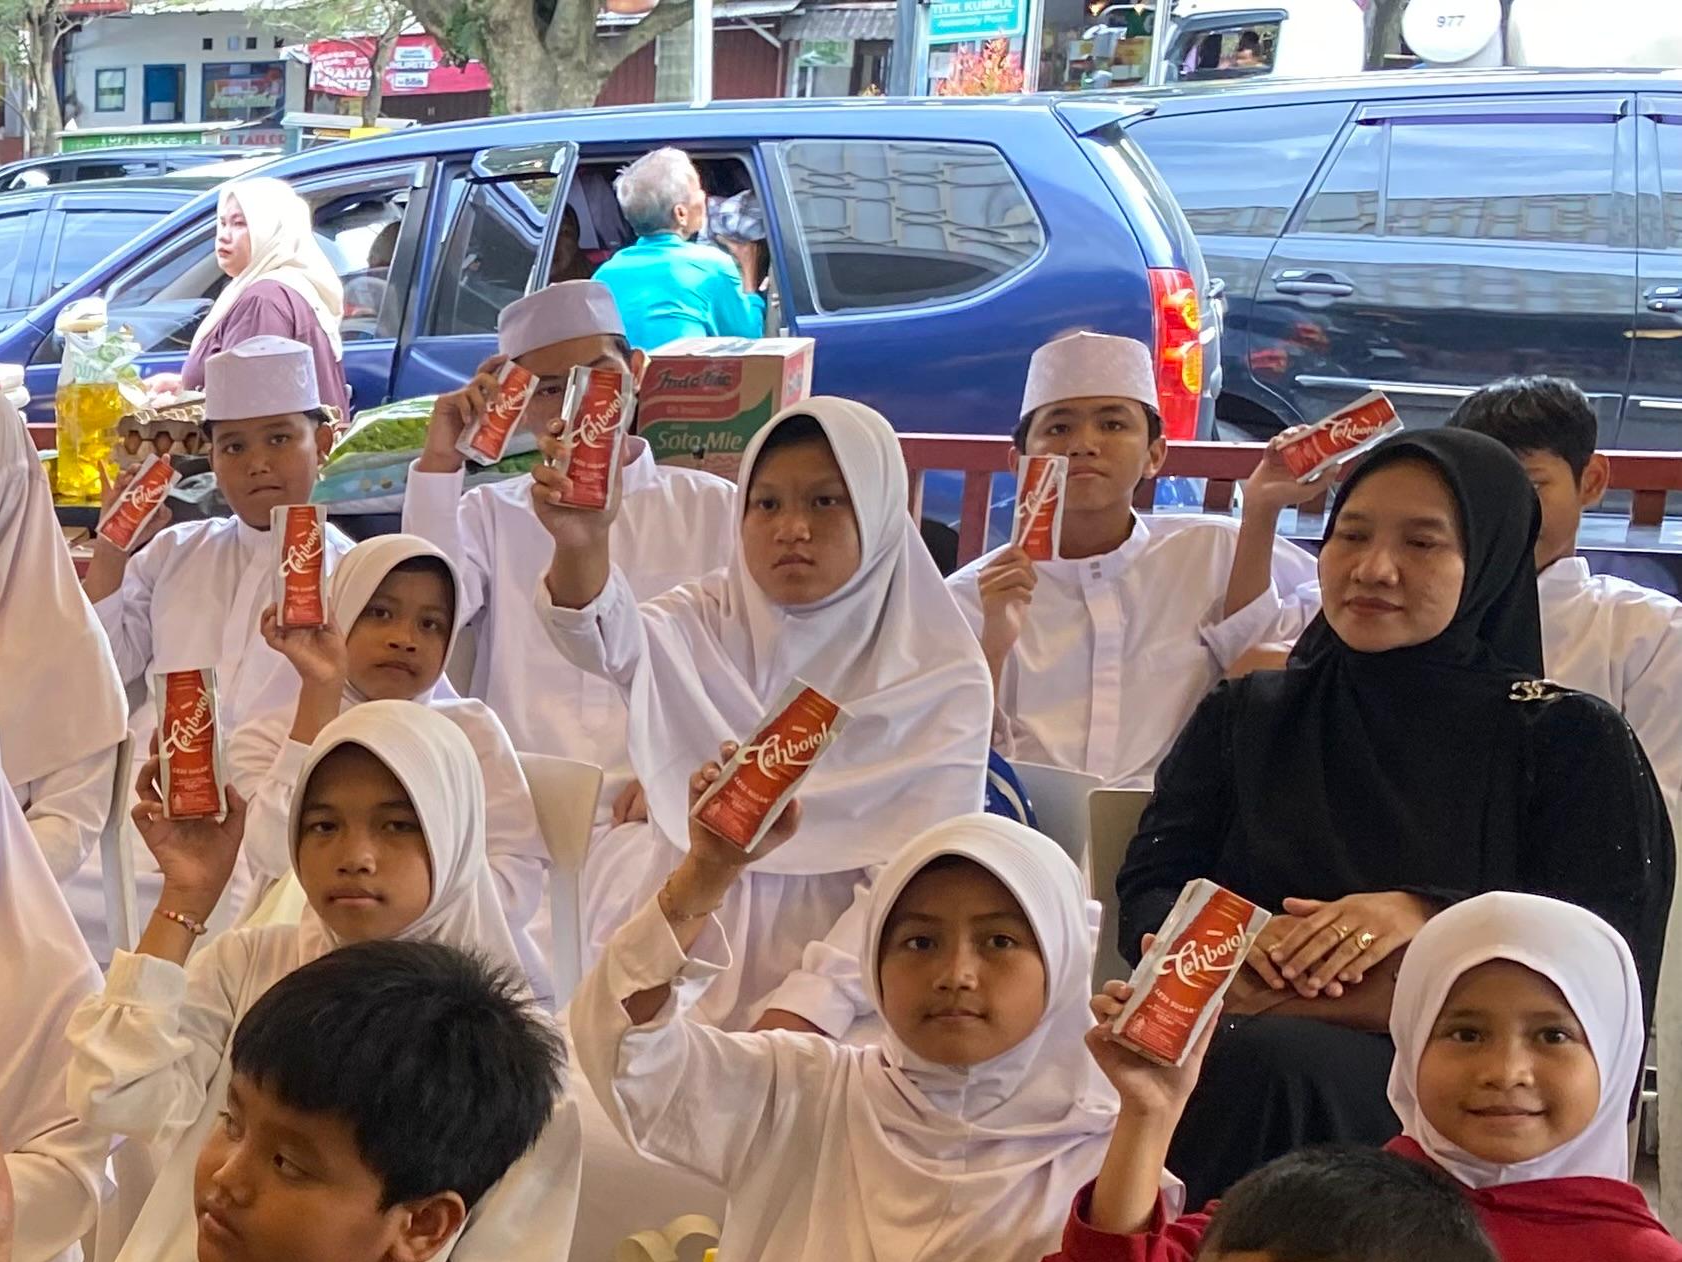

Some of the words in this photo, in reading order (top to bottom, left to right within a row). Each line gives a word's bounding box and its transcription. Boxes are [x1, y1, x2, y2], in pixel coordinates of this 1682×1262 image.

[937, 16, 981, 28] Assembly
[983, 13, 1009, 24] Point
[238, 134, 286, 146] TAILOR
[657, 431, 701, 450] Soto
[706, 431, 743, 450] Mie
[158, 687, 216, 760] Tehbotol
[734, 721, 838, 781] Tehbotol
[1152, 923, 1257, 989] Tehbotol
[1154, 988, 1170, 1004] LESS
[1170, 1000, 1196, 1014] SUGAR
